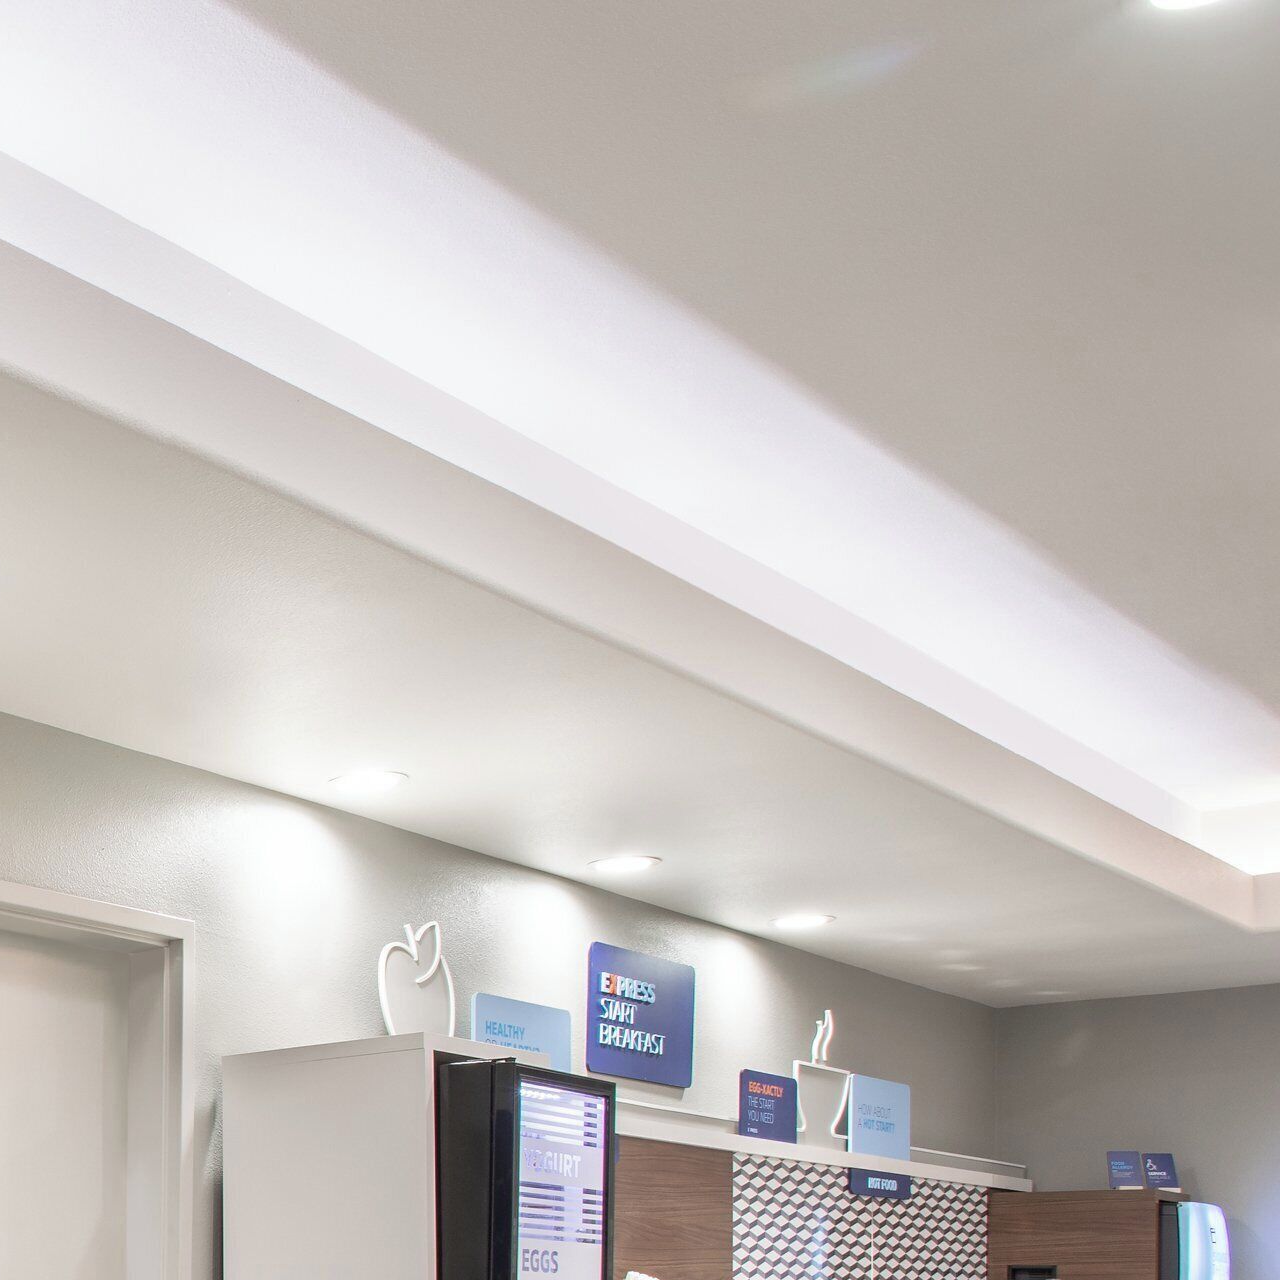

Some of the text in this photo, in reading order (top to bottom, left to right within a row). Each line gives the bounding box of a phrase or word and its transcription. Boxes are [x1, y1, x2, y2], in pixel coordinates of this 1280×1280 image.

[600, 971, 656, 1004] EXPRESS
[599, 998, 638, 1025] START
[485, 1020, 525, 1040] HEALTHY
[599, 1023, 666, 1055] BREAKFAST
[748, 1095, 775, 1111] THE START
[748, 1109, 760, 1122] YOU
[881, 1179, 898, 1192] FOOD
[521, 1249, 559, 1274] EGGS
